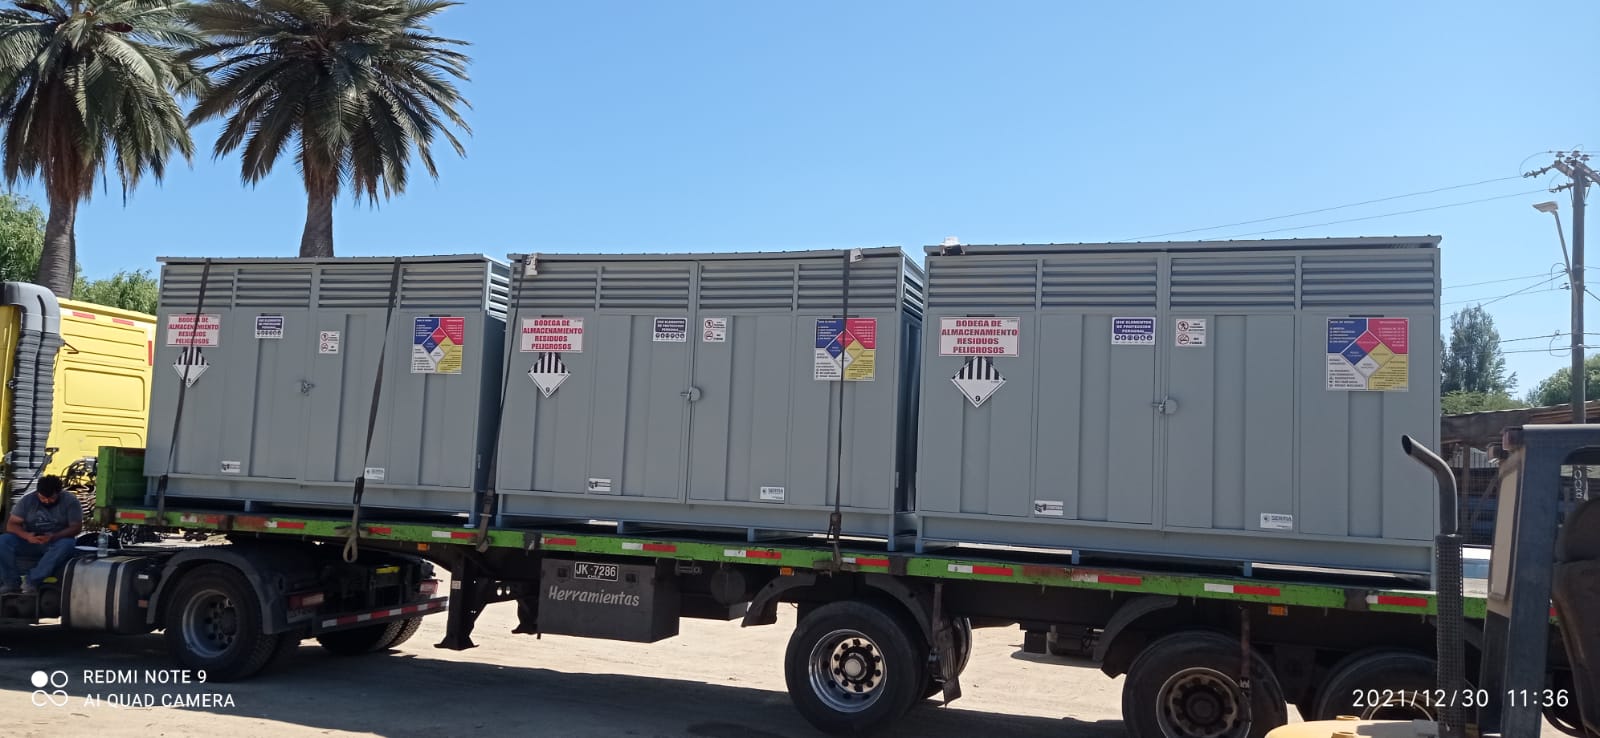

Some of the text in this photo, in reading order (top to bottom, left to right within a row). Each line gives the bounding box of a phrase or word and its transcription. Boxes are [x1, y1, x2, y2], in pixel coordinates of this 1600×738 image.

[952, 346, 1005, 354] PELIGROSOS
[576, 564, 617, 577] JK 7286
[548, 585, 640, 607] Herramientas
